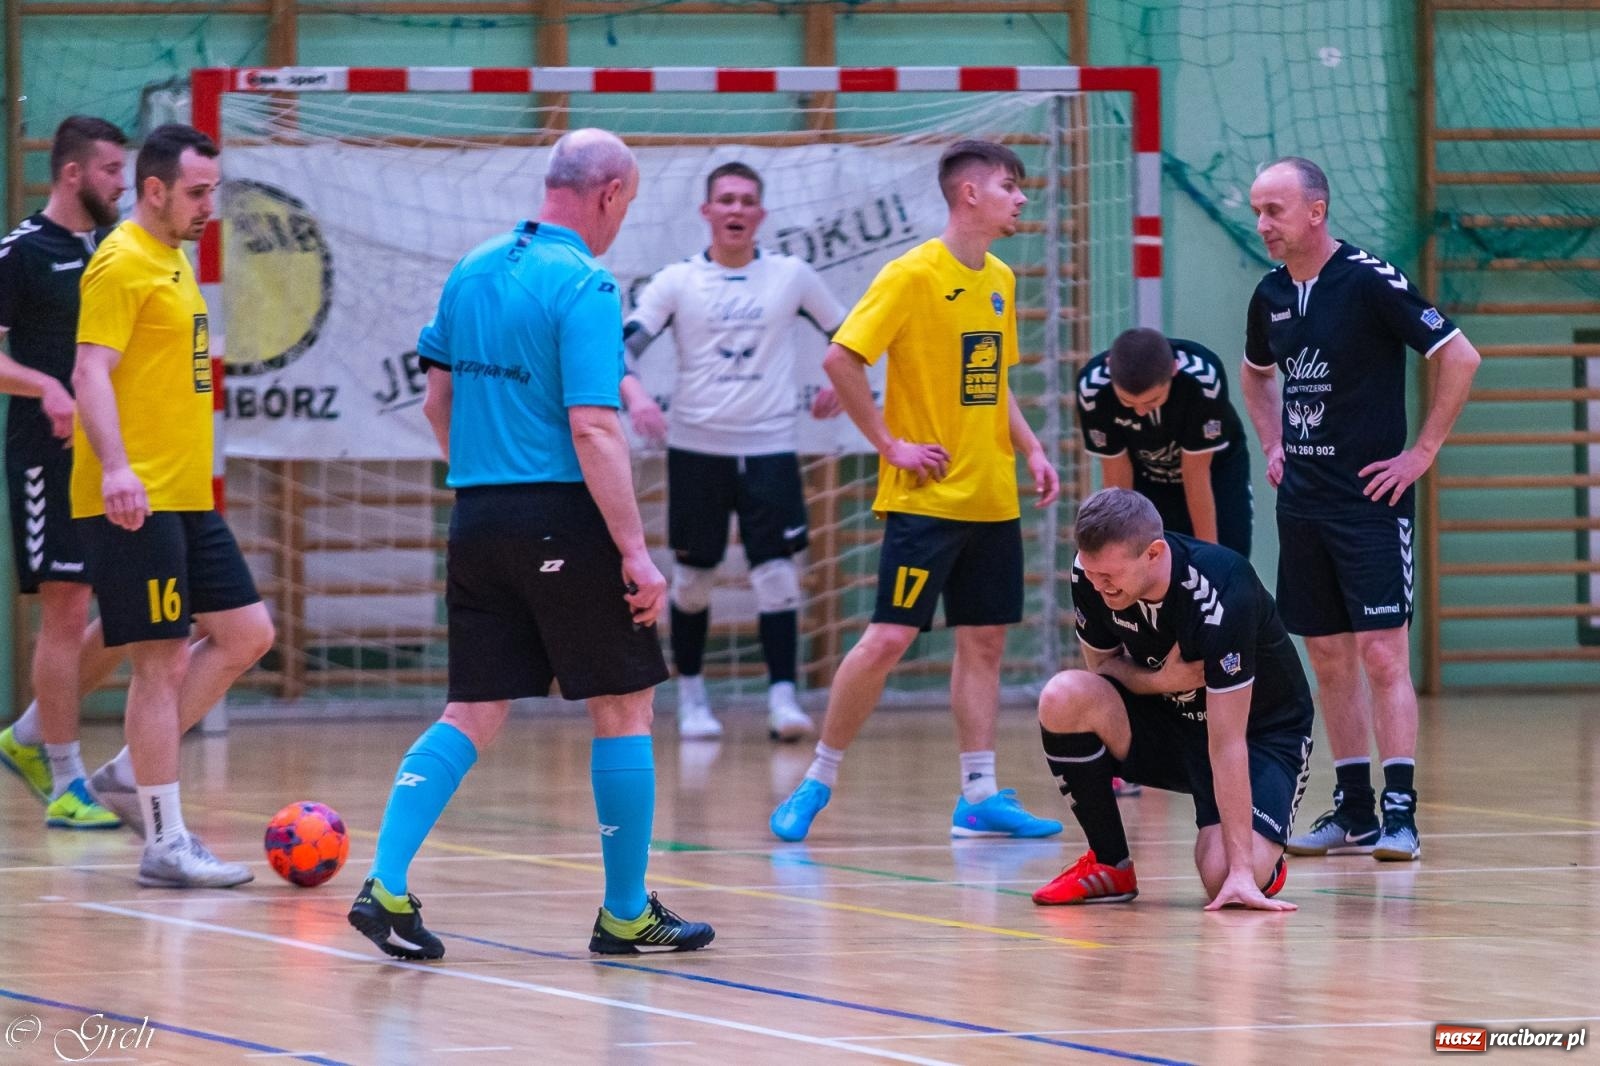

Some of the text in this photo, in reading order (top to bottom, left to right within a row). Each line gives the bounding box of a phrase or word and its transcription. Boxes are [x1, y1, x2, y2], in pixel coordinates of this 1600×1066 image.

[1286, 346, 1330, 381] Ada
[1298, 444, 1314, 456] 260
[1316, 445, 1336, 456] 902
[147, 577, 182, 624] 16
[892, 566, 930, 609] 17
[1364, 602, 1400, 616] hummel
